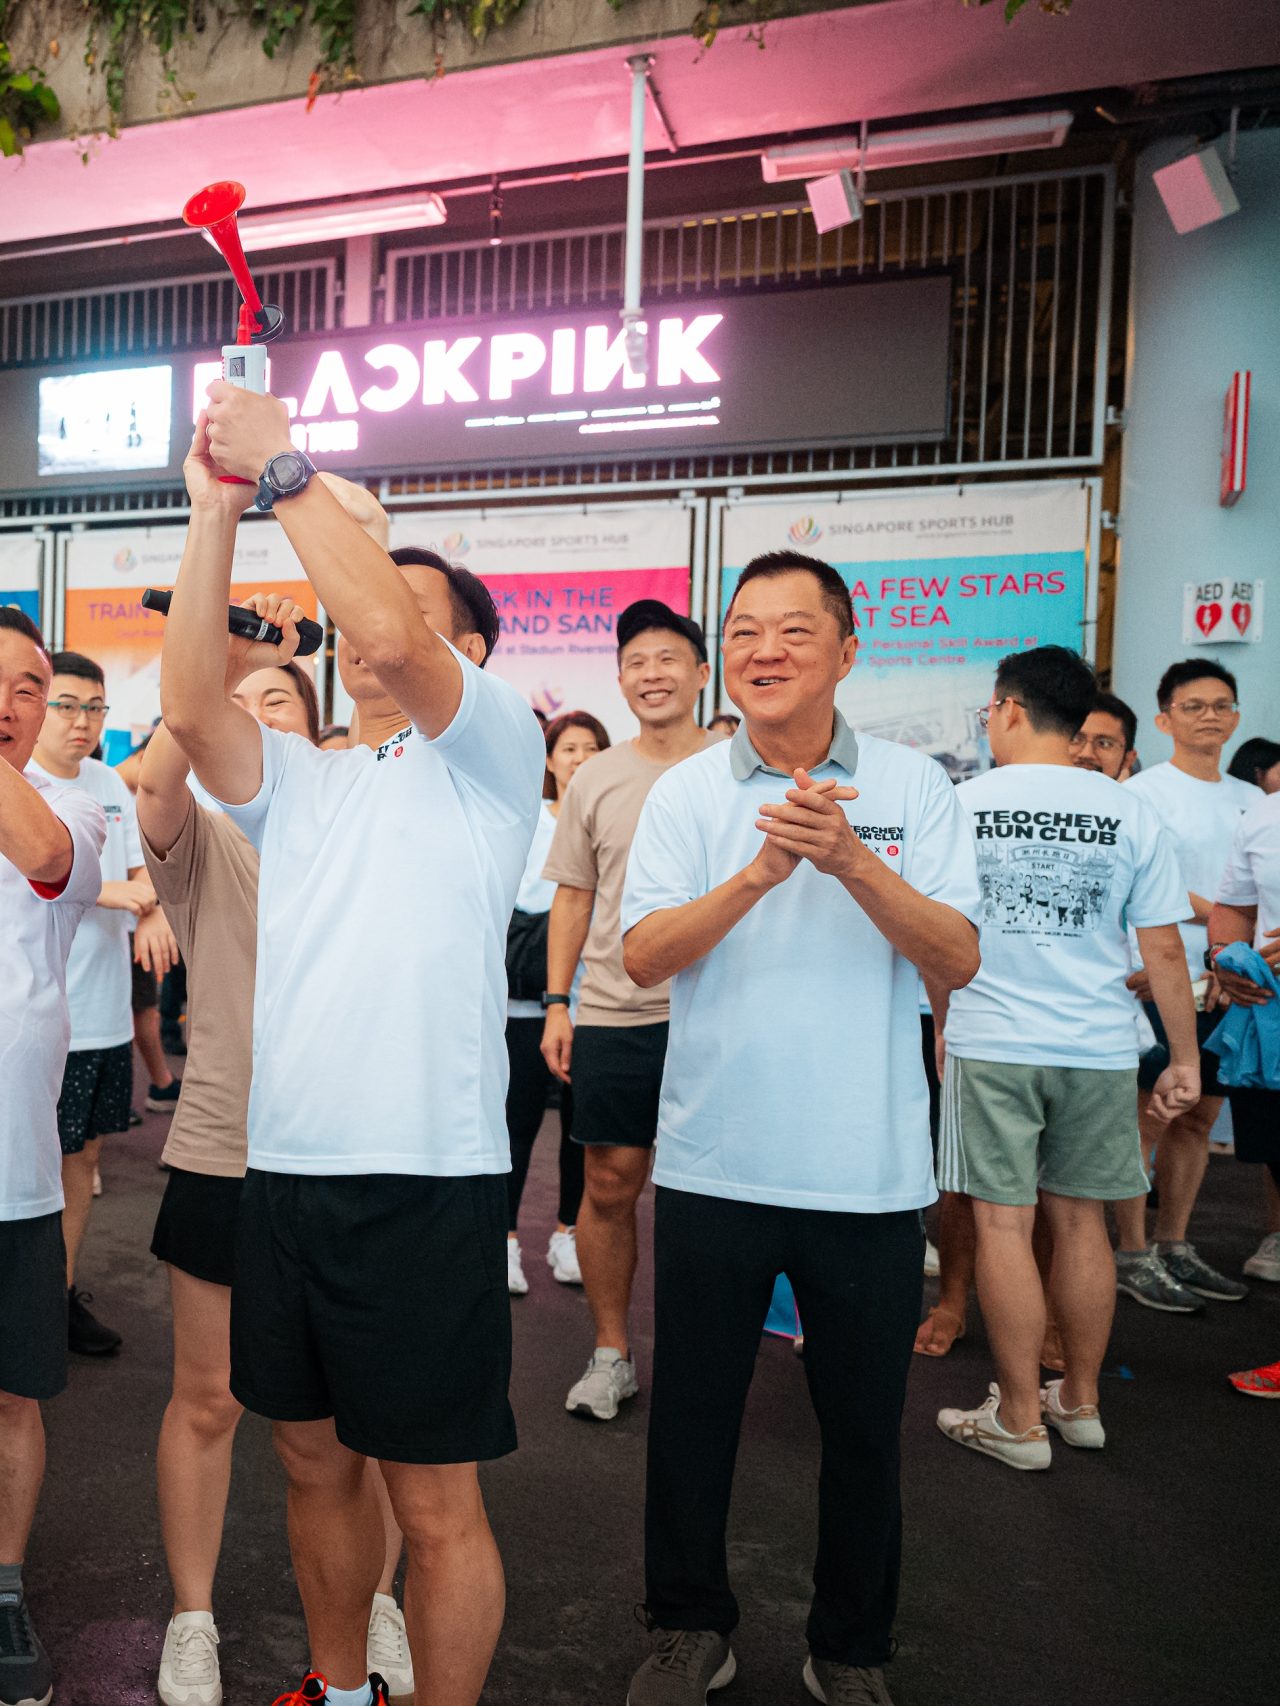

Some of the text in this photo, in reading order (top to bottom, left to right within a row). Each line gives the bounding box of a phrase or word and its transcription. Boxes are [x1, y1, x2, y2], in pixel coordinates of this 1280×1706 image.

[829, 520, 913, 536] SINGAPORE
[919, 517, 977, 530] SPORTS
[981, 514, 1014, 527] HUB
[476, 533, 629, 549] SINGAPORE SPORTS HUB
[880, 577, 950, 600] FEW
[959, 571, 1066, 598] STARS
[1196, 582, 1223, 601] AED
[1232, 581, 1254, 601] AED
[490, 586, 615, 608] SK IN THE
[87, 602, 151, 622] TRAIN
[890, 604, 951, 628] SEA
[558, 613, 621, 634] SAN
[872, 638, 934, 650] Personal
[939, 638, 968, 648] Skill
[973, 636, 1019, 648] Award
[869, 655, 913, 667] Sports
[917, 654, 966, 665] Centre
[973, 810, 1122, 832] TEOCHEW
[976, 824, 1117, 846] RUN CLUB
